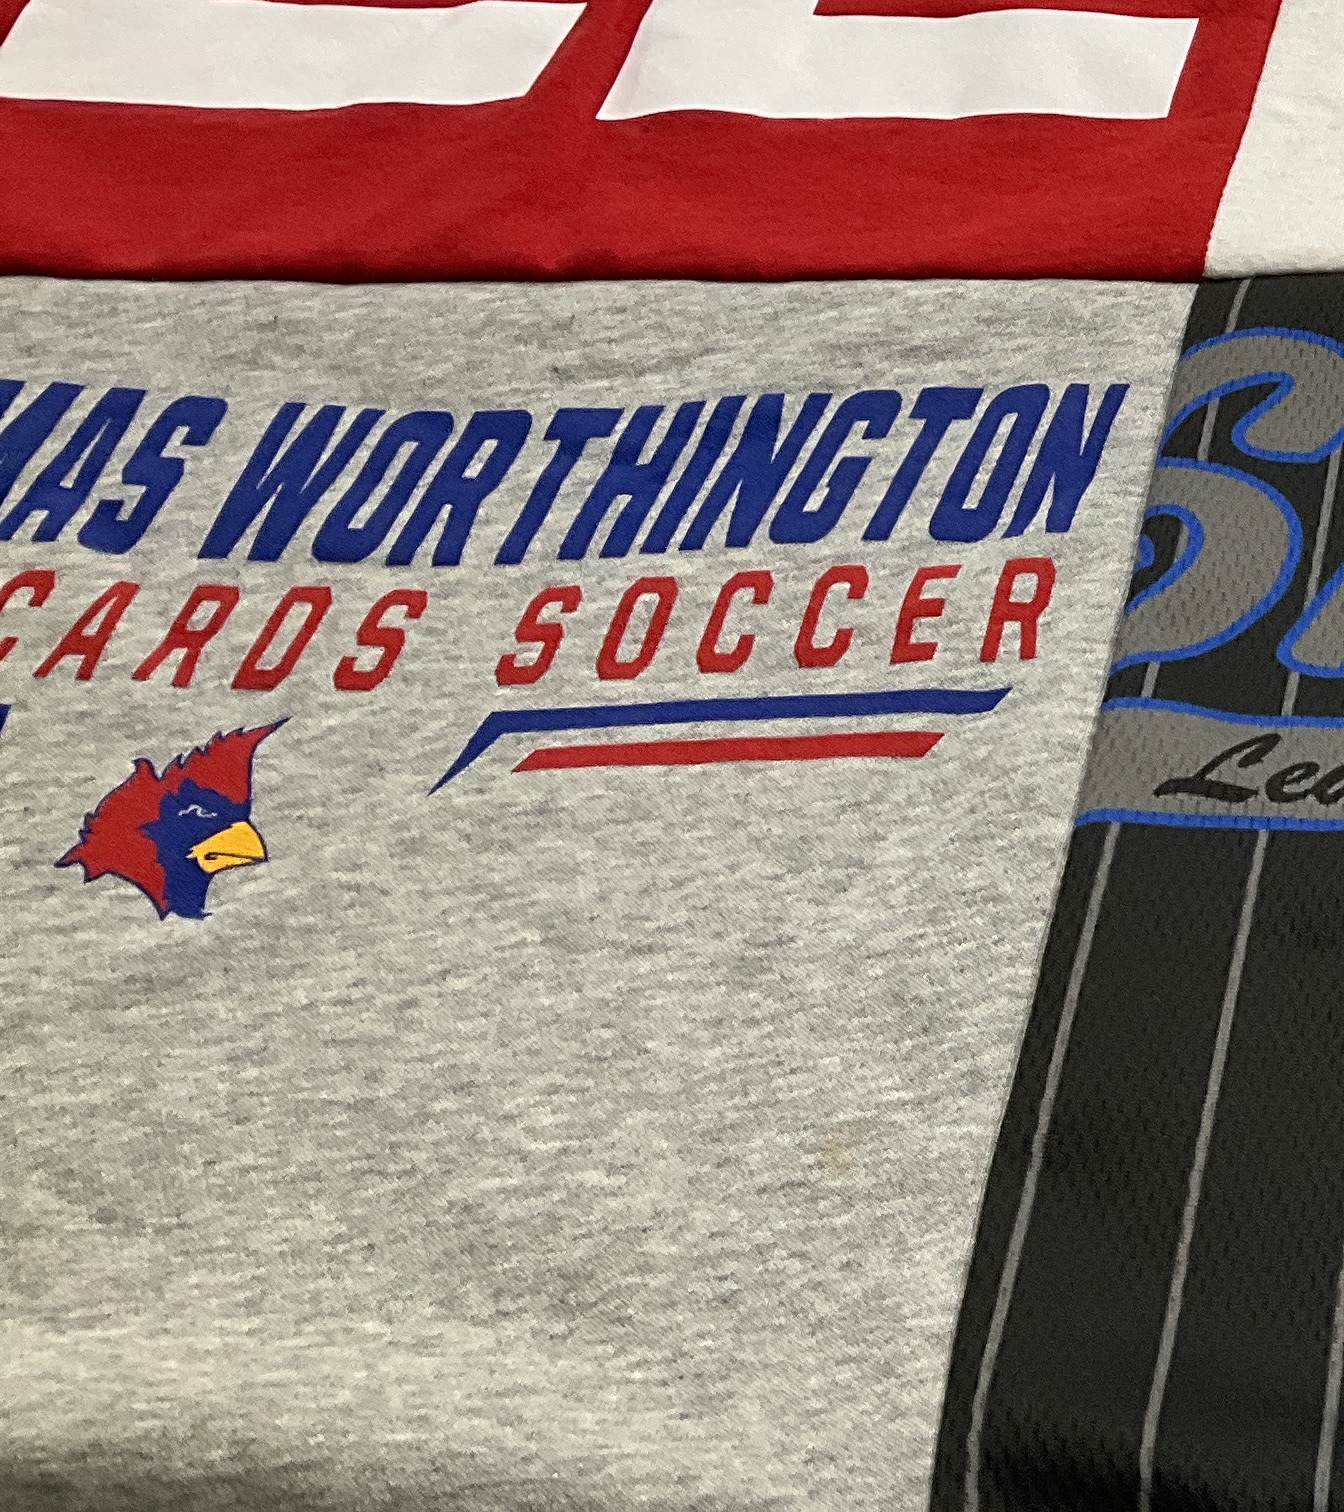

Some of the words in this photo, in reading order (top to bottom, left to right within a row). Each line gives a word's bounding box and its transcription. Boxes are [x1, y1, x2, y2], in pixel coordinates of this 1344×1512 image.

[199, 383, 1127, 566] WORTHINGTON
[0, 570, 428, 691] CARDS
[495, 557, 1057, 687] SOCCER
